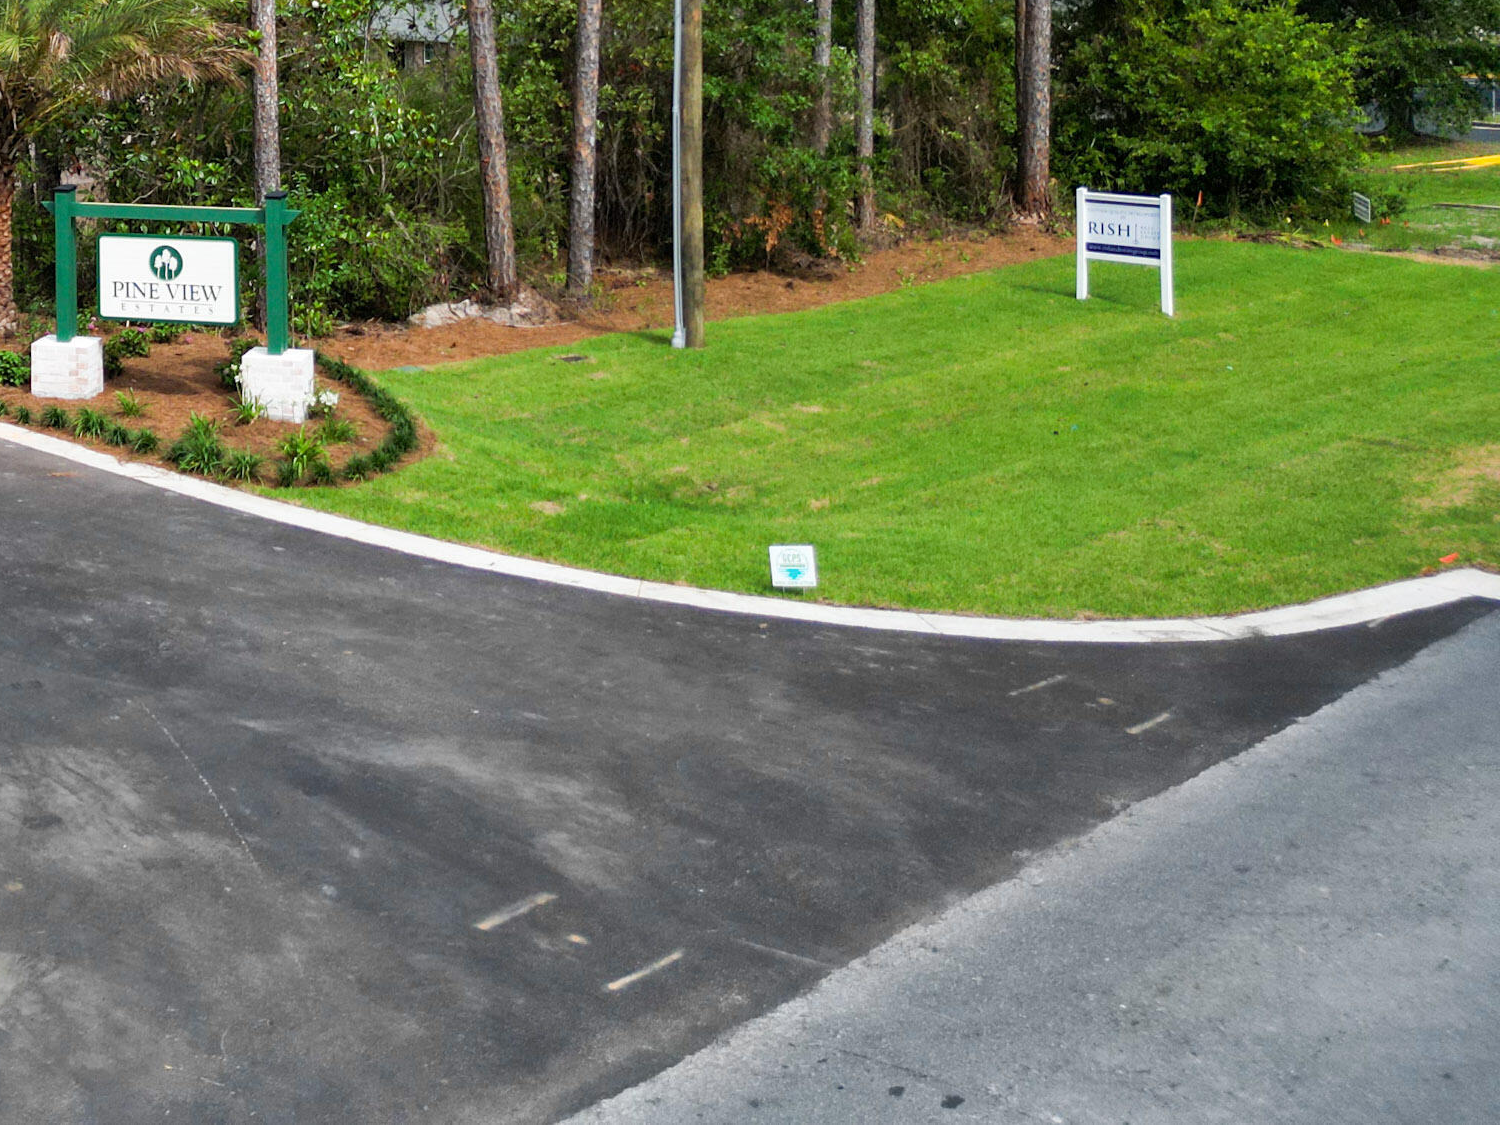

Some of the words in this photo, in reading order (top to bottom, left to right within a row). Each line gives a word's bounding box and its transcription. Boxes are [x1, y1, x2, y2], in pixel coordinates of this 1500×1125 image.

[1088, 221, 1130, 237] RISH
[112, 281, 161, 300] PINE
[166, 283, 222, 302] VIEW
[121, 302, 214, 315] ESTATES
